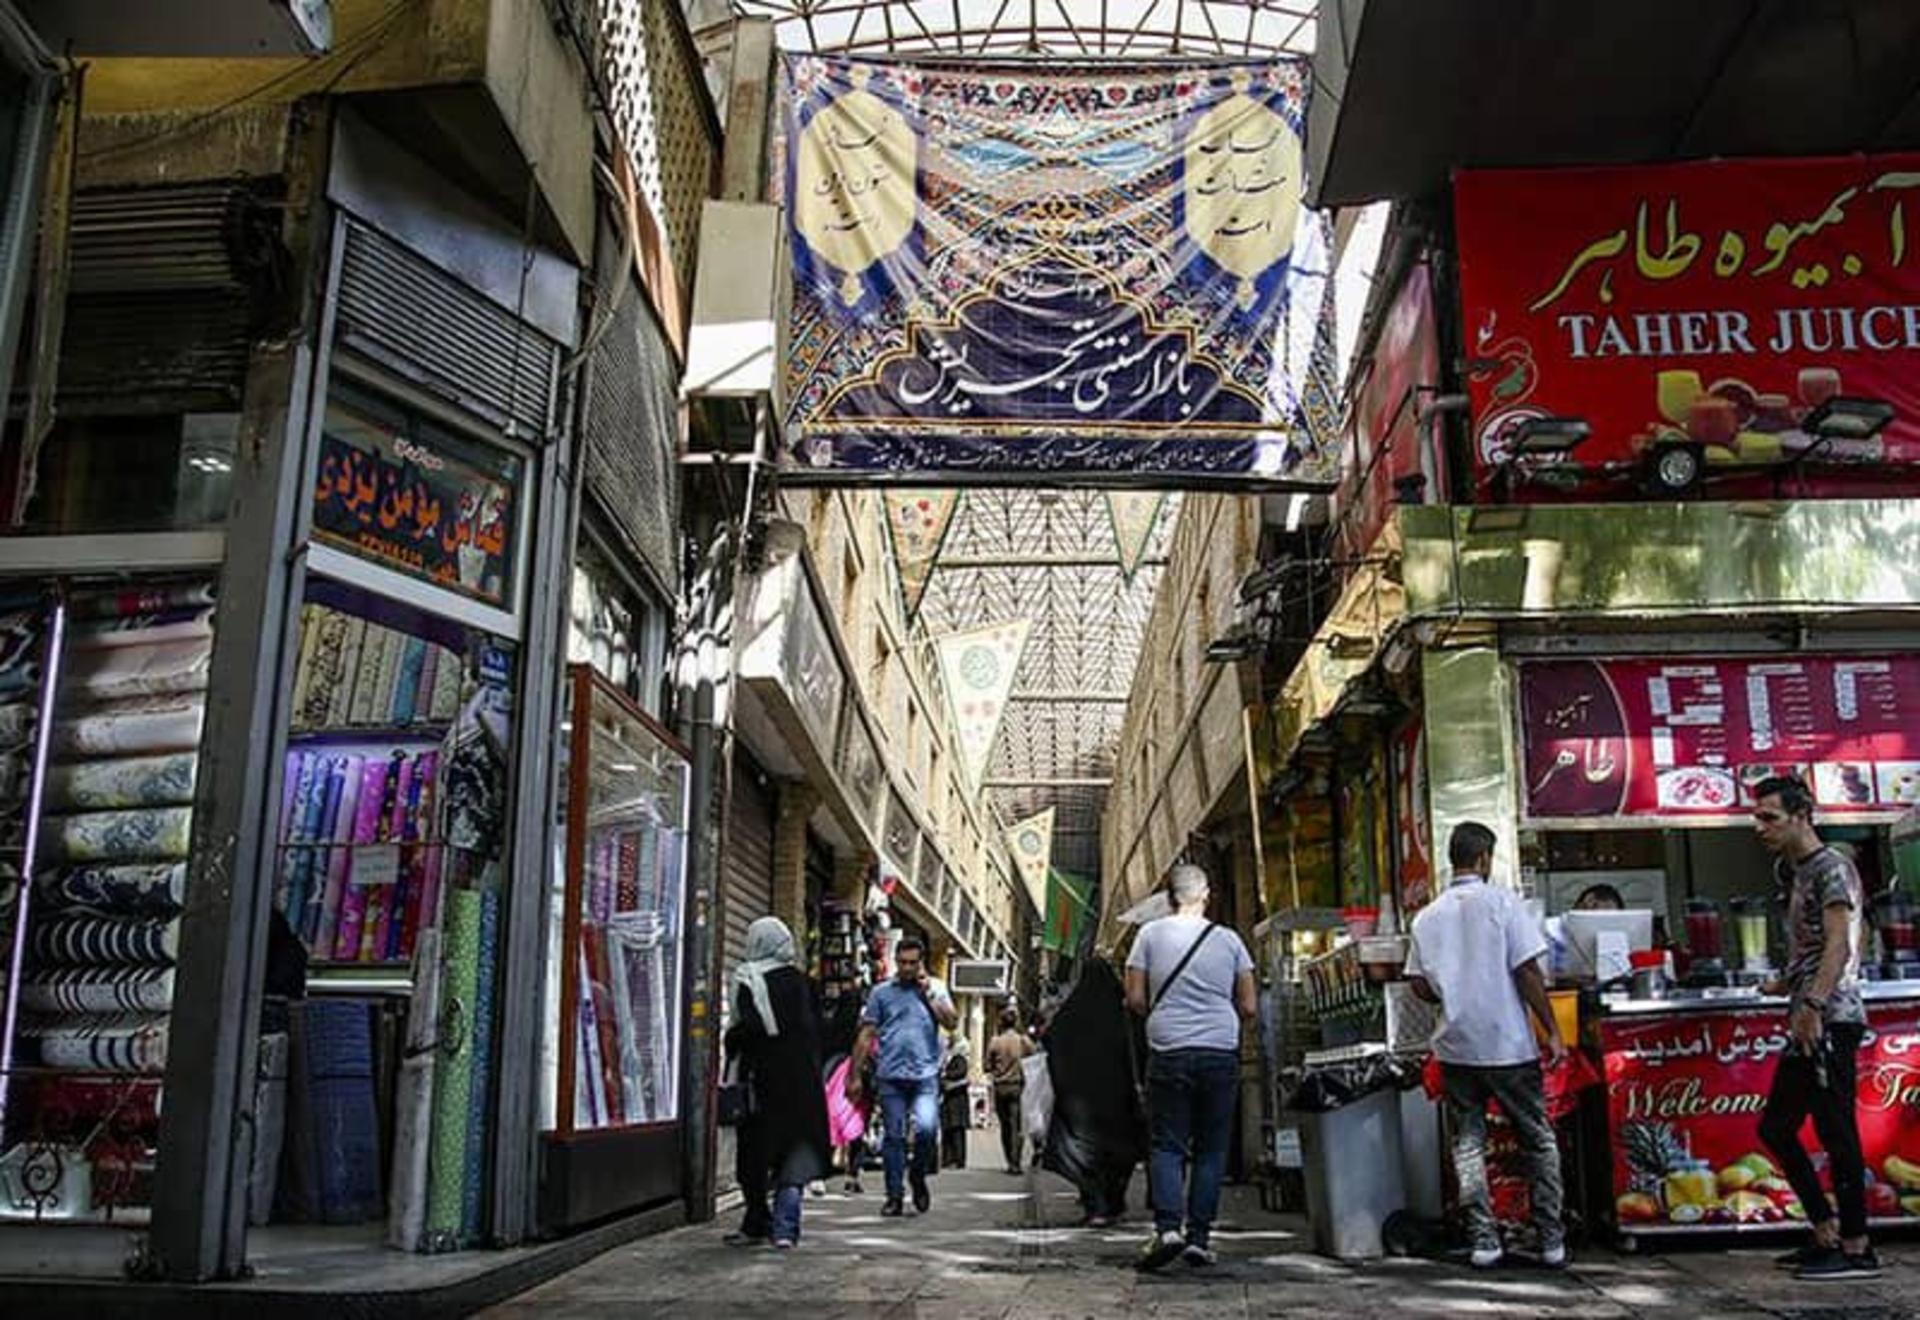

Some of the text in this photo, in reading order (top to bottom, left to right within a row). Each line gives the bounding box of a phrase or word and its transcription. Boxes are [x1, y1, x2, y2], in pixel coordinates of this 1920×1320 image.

[1530, 199, 1701, 312] طاهر
[1559, 310, 1755, 358] TAHER
[899, 320, 1193, 413] بازار سنتی تجریش
[315, 450, 377, 524] یزدی
[1532, 737, 1616, 796] طاهر
[1716, 1024, 1791, 1063] خوش
[1608, 1076, 1769, 1119] Welcom
